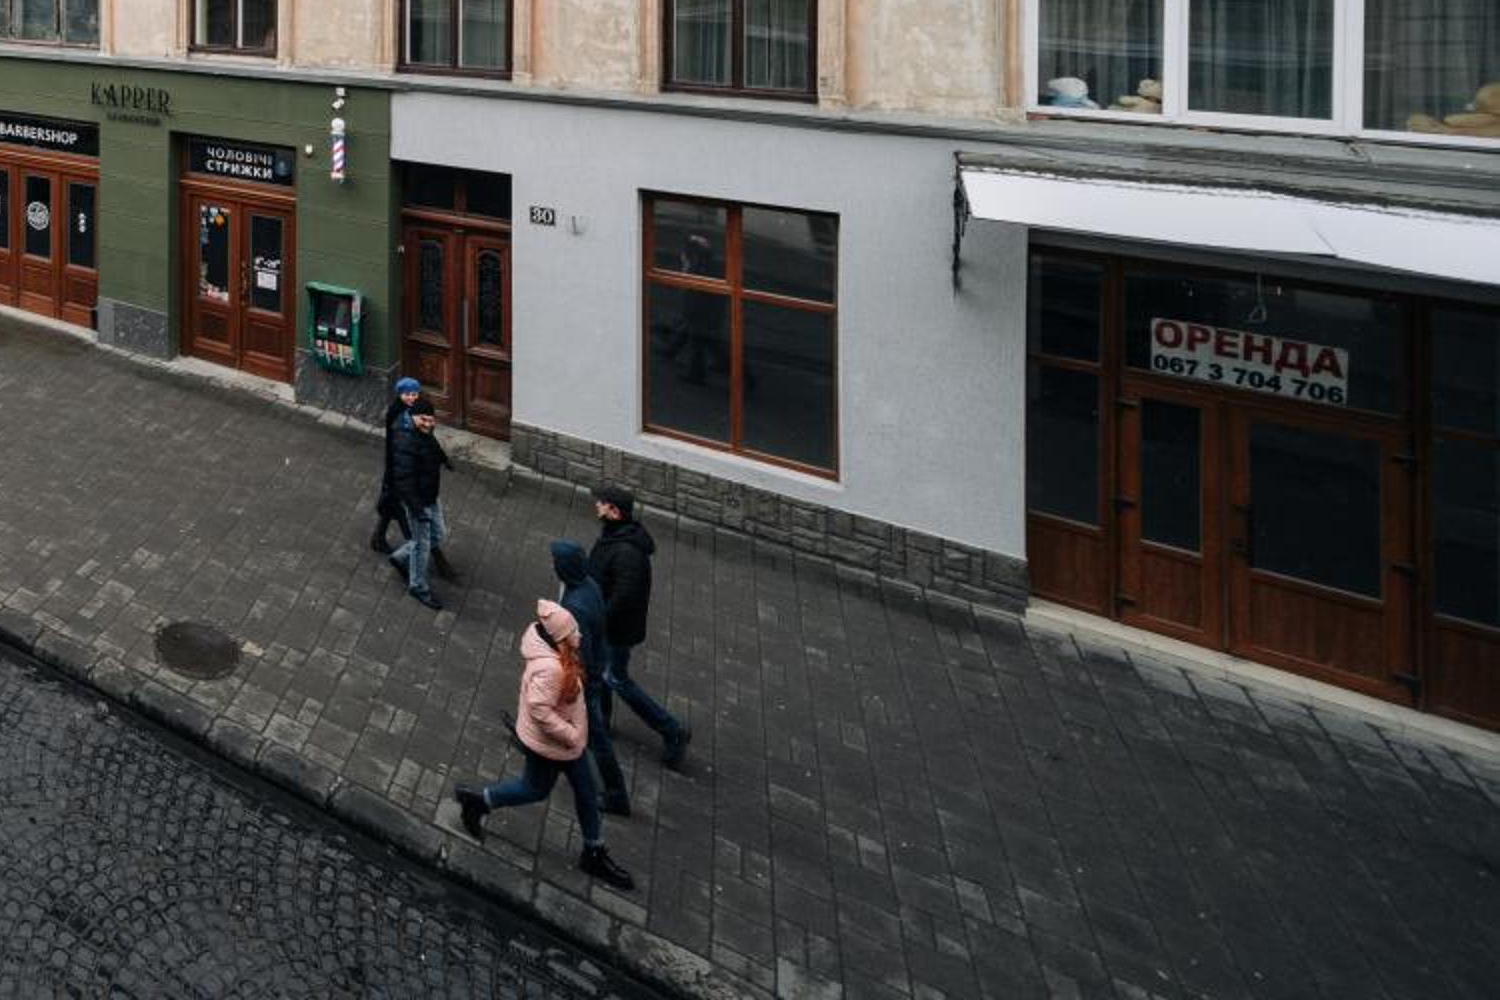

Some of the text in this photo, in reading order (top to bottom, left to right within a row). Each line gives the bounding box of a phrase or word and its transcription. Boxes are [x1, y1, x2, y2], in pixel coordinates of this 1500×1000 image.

[0, 122, 78, 145] BARBERSHOP
[206, 146, 274, 166] ЧОЛОВІЧІ
[206, 159, 273, 179] СТРИЖКИ
[1155, 322, 1343, 379] ОРЕНДА
[1154, 354, 1344, 403] 067 3 704 706
